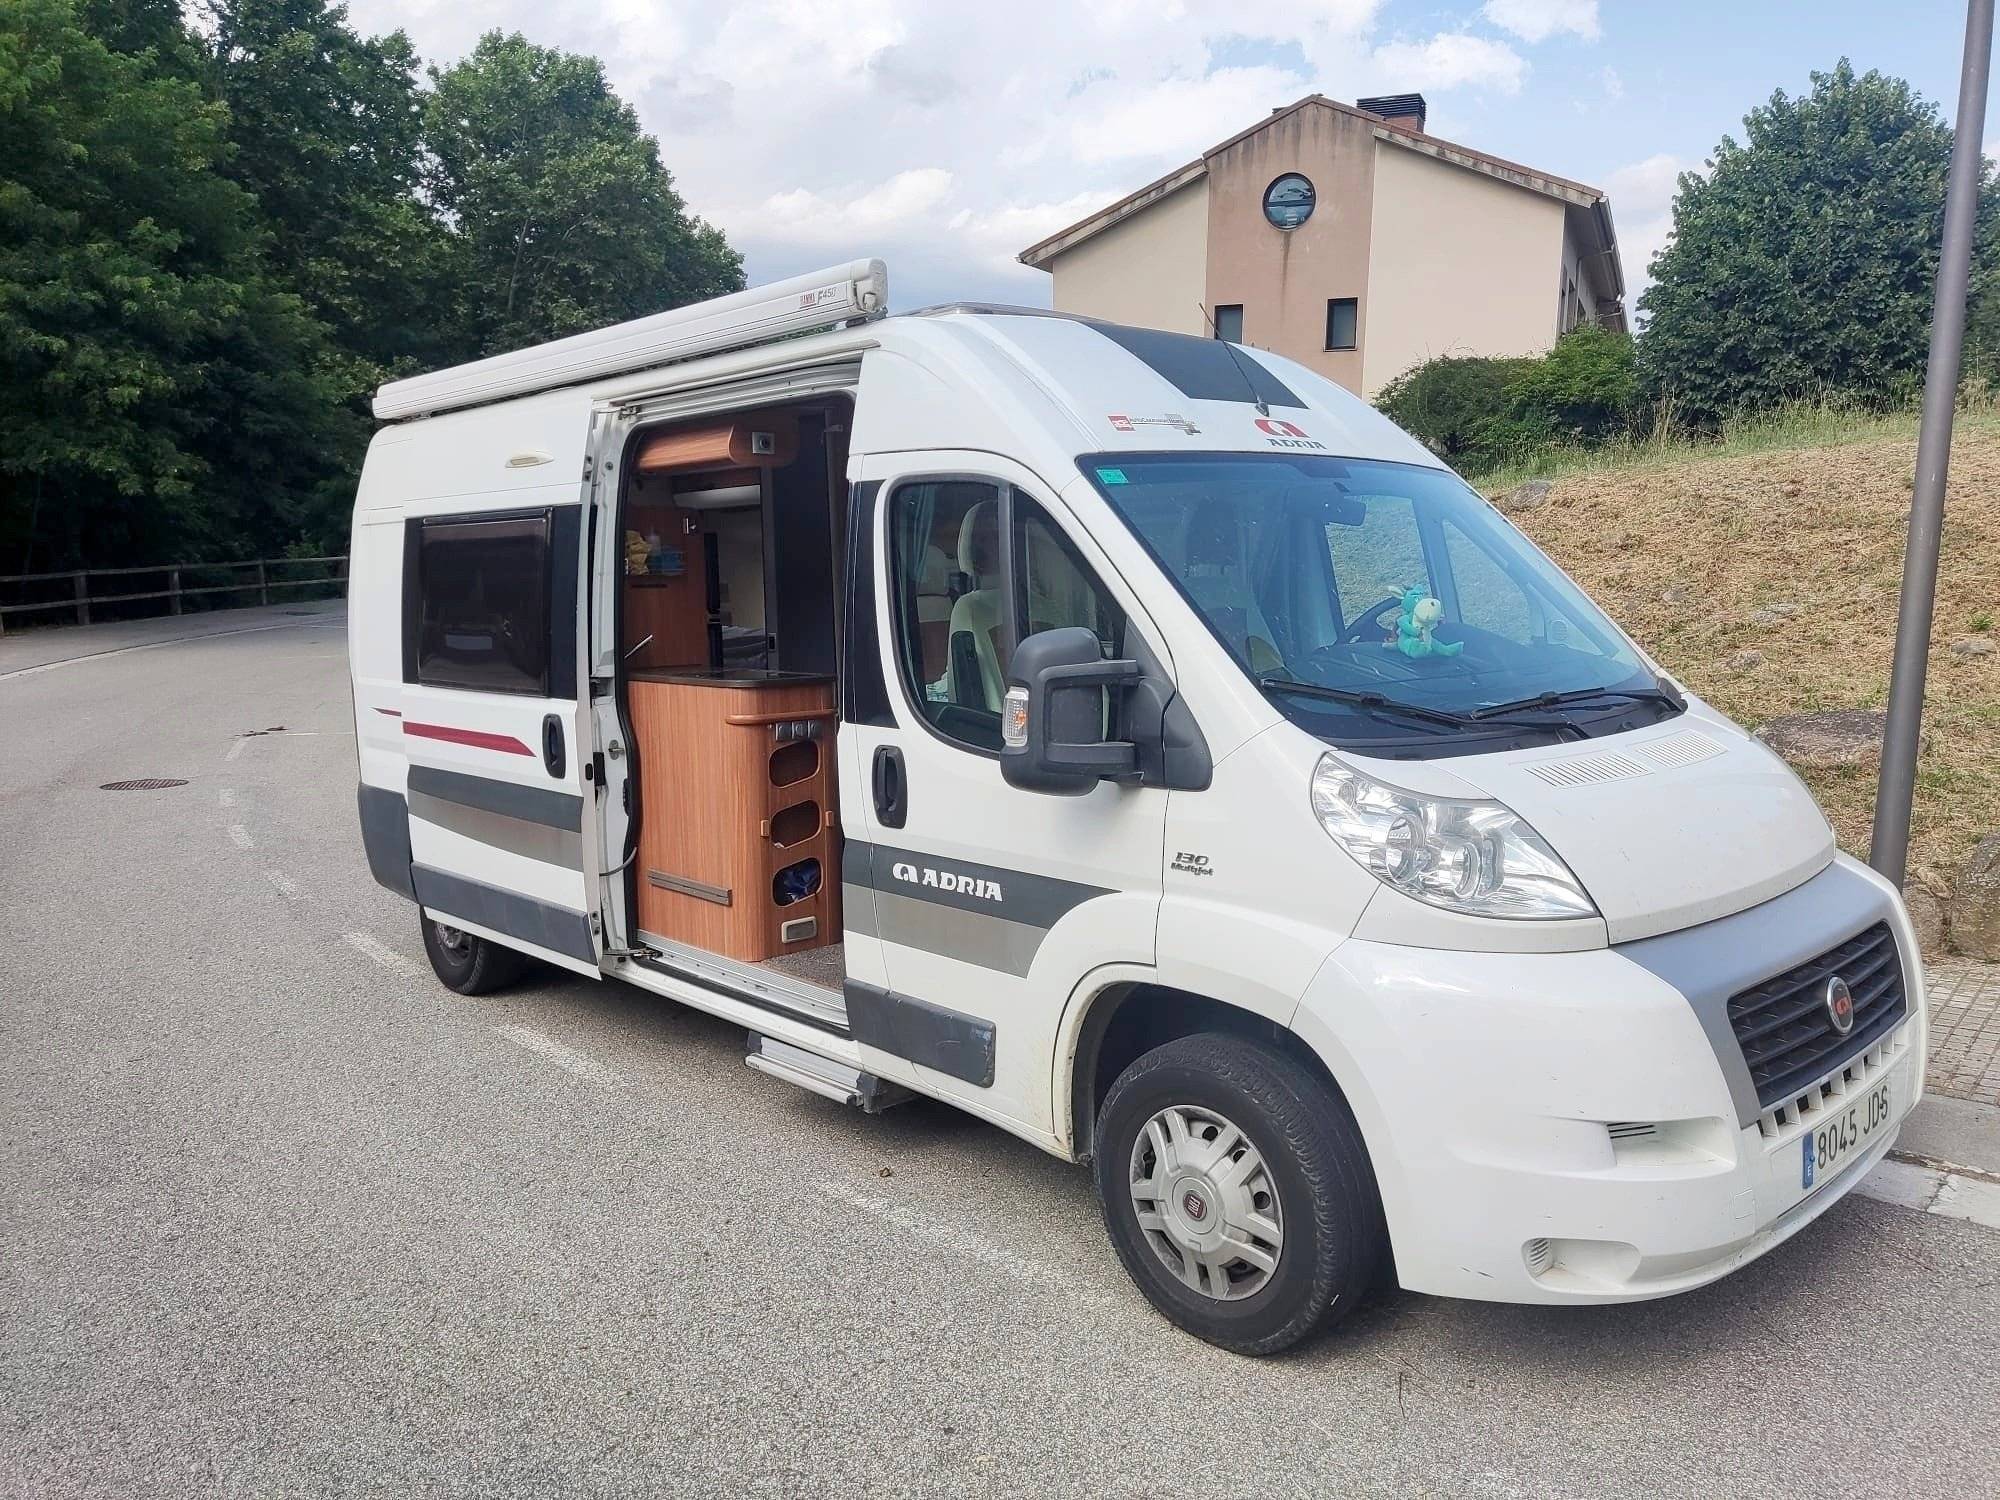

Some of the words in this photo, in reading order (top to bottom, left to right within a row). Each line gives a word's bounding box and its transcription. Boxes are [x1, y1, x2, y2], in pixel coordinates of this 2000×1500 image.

[1266, 438, 1328, 450] ADRIA
[1175, 851, 1209, 866] 130
[922, 868, 1003, 902] ADRIA
[1817, 1109, 1857, 1170] 8045
[1863, 1085, 1888, 1135] JDS
